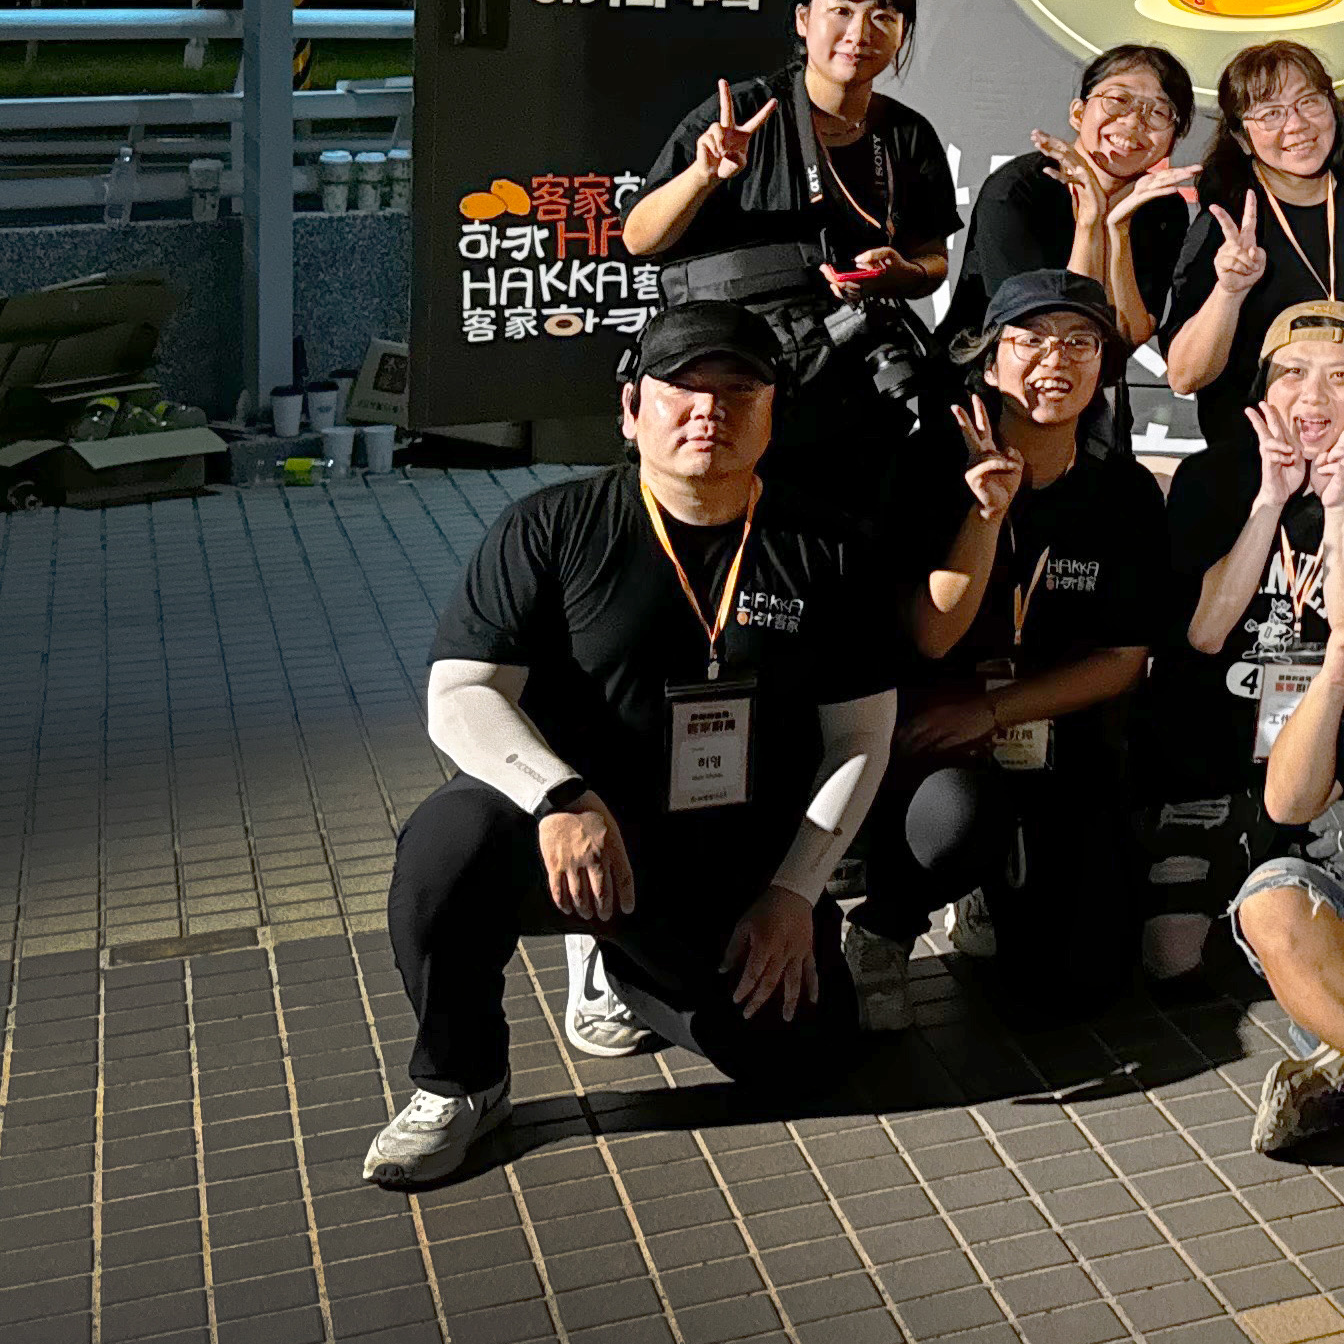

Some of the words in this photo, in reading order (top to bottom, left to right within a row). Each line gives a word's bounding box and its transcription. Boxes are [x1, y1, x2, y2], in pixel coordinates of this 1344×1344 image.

[462, 259, 629, 310] HAKKA
[1047, 558, 1100, 581] HAKKA
[738, 590, 804, 616] HAKKA
[1240, 668, 1259, 695] 4
